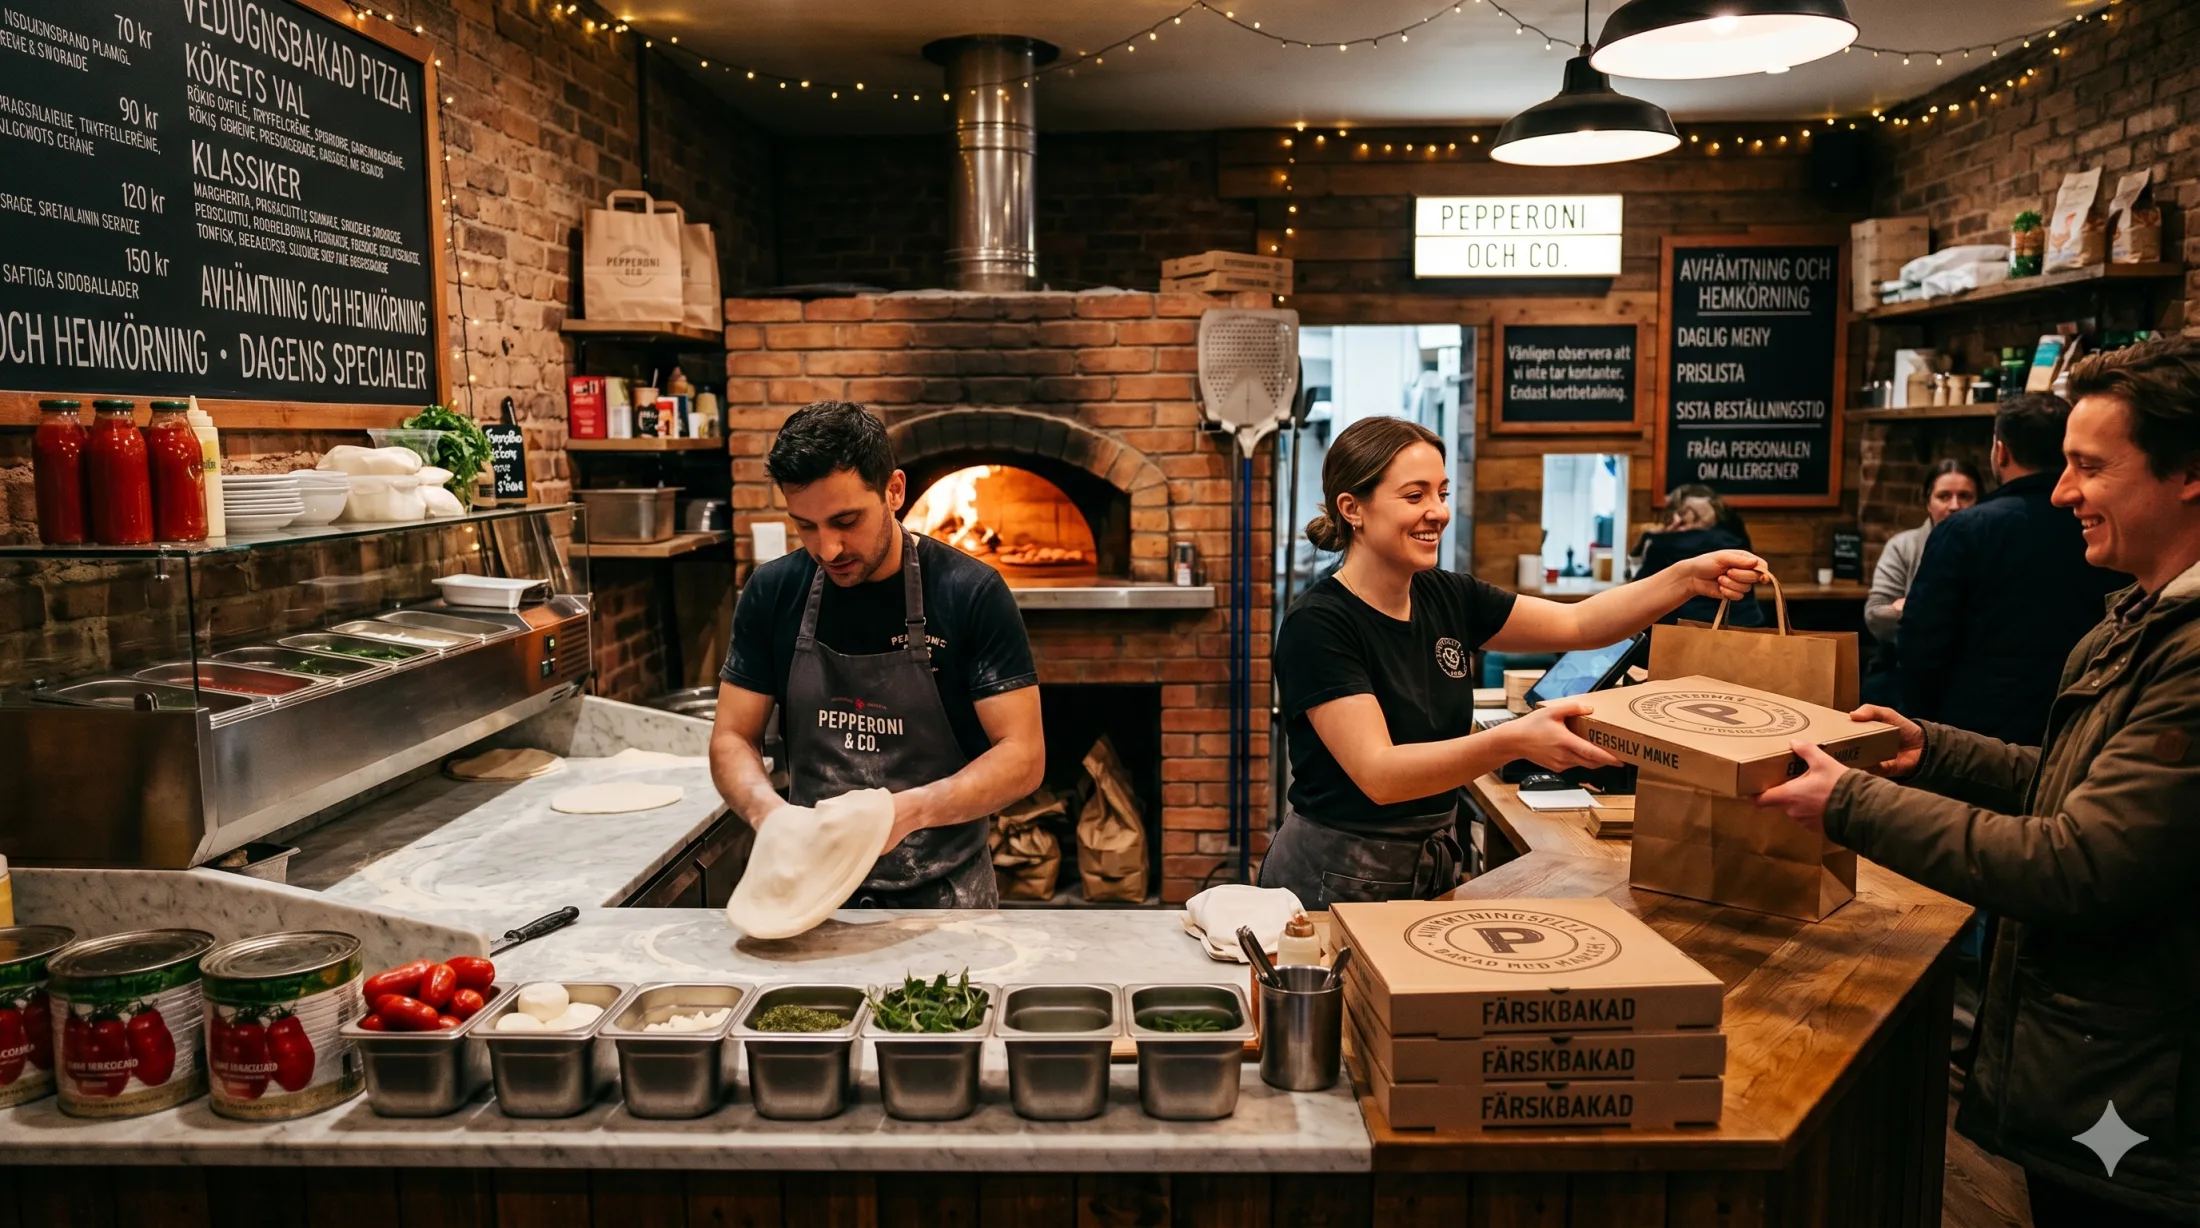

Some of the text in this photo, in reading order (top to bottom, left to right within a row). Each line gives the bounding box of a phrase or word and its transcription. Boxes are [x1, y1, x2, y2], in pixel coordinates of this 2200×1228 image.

[114, 13, 152, 50] 70 kr
[185, 41, 310, 119] KÖKETS VAL
[360, 53, 412, 114] PIZZA
[187, 84, 216, 108] RÖKIG
[120, 97, 159, 131] 90 kr
[191, 139, 301, 201] KLASSIKER
[121, 182, 165, 214] 120 kr
[194, 181, 254, 212] MARGHERITA,
[1441, 204, 1585, 231] PEPPERONI
[196, 222, 237, 247] TONFISK,
[125, 247, 170, 278] 150 kr
[1468, 242, 1568, 268] OCH CO.
[1679, 253, 1830, 282] AVHÄMTNING OCH
[3, 263, 139, 299] SAFTIGA SIDOBALLADER
[201, 262, 427, 337] AVHÄMTNING OCH HEMKÖRNING
[1698, 282, 1810, 310] HEMKÖRNING
[1677, 326, 1771, 348] DAGLIG MENY
[54, 312, 208, 376] HEMKÖRNING
[240, 333, 328, 384] DAGENS
[332, 342, 427, 391] SPECIALER
[1508, 344, 1631, 365] Vänligen observera att
[1513, 364, 1624, 380] vi inte tar kontanter.
[1676, 363, 1745, 383] PRISLISTA
[1510, 384, 1627, 403] Endast kortbetalning.
[1676, 398, 1825, 420] SISTA BESTÄLLNINGSTID
[1687, 437, 1811, 459] FRÅGA PERSONALEN
[1698, 462, 1799, 480] OM ALLERGENER
[818, 709, 904, 736] PEPPERONI
[1677, 703, 1746, 726] P
[844, 732, 880, 752] & CO.
[1472, 927, 1545, 954] P
[1482, 996, 1636, 1026] FÄRSKBAKAD
[1481, 1046, 1635, 1074] FÄRSKBAKAD
[1480, 1093, 1634, 1121] FÄRSKBAKAD
